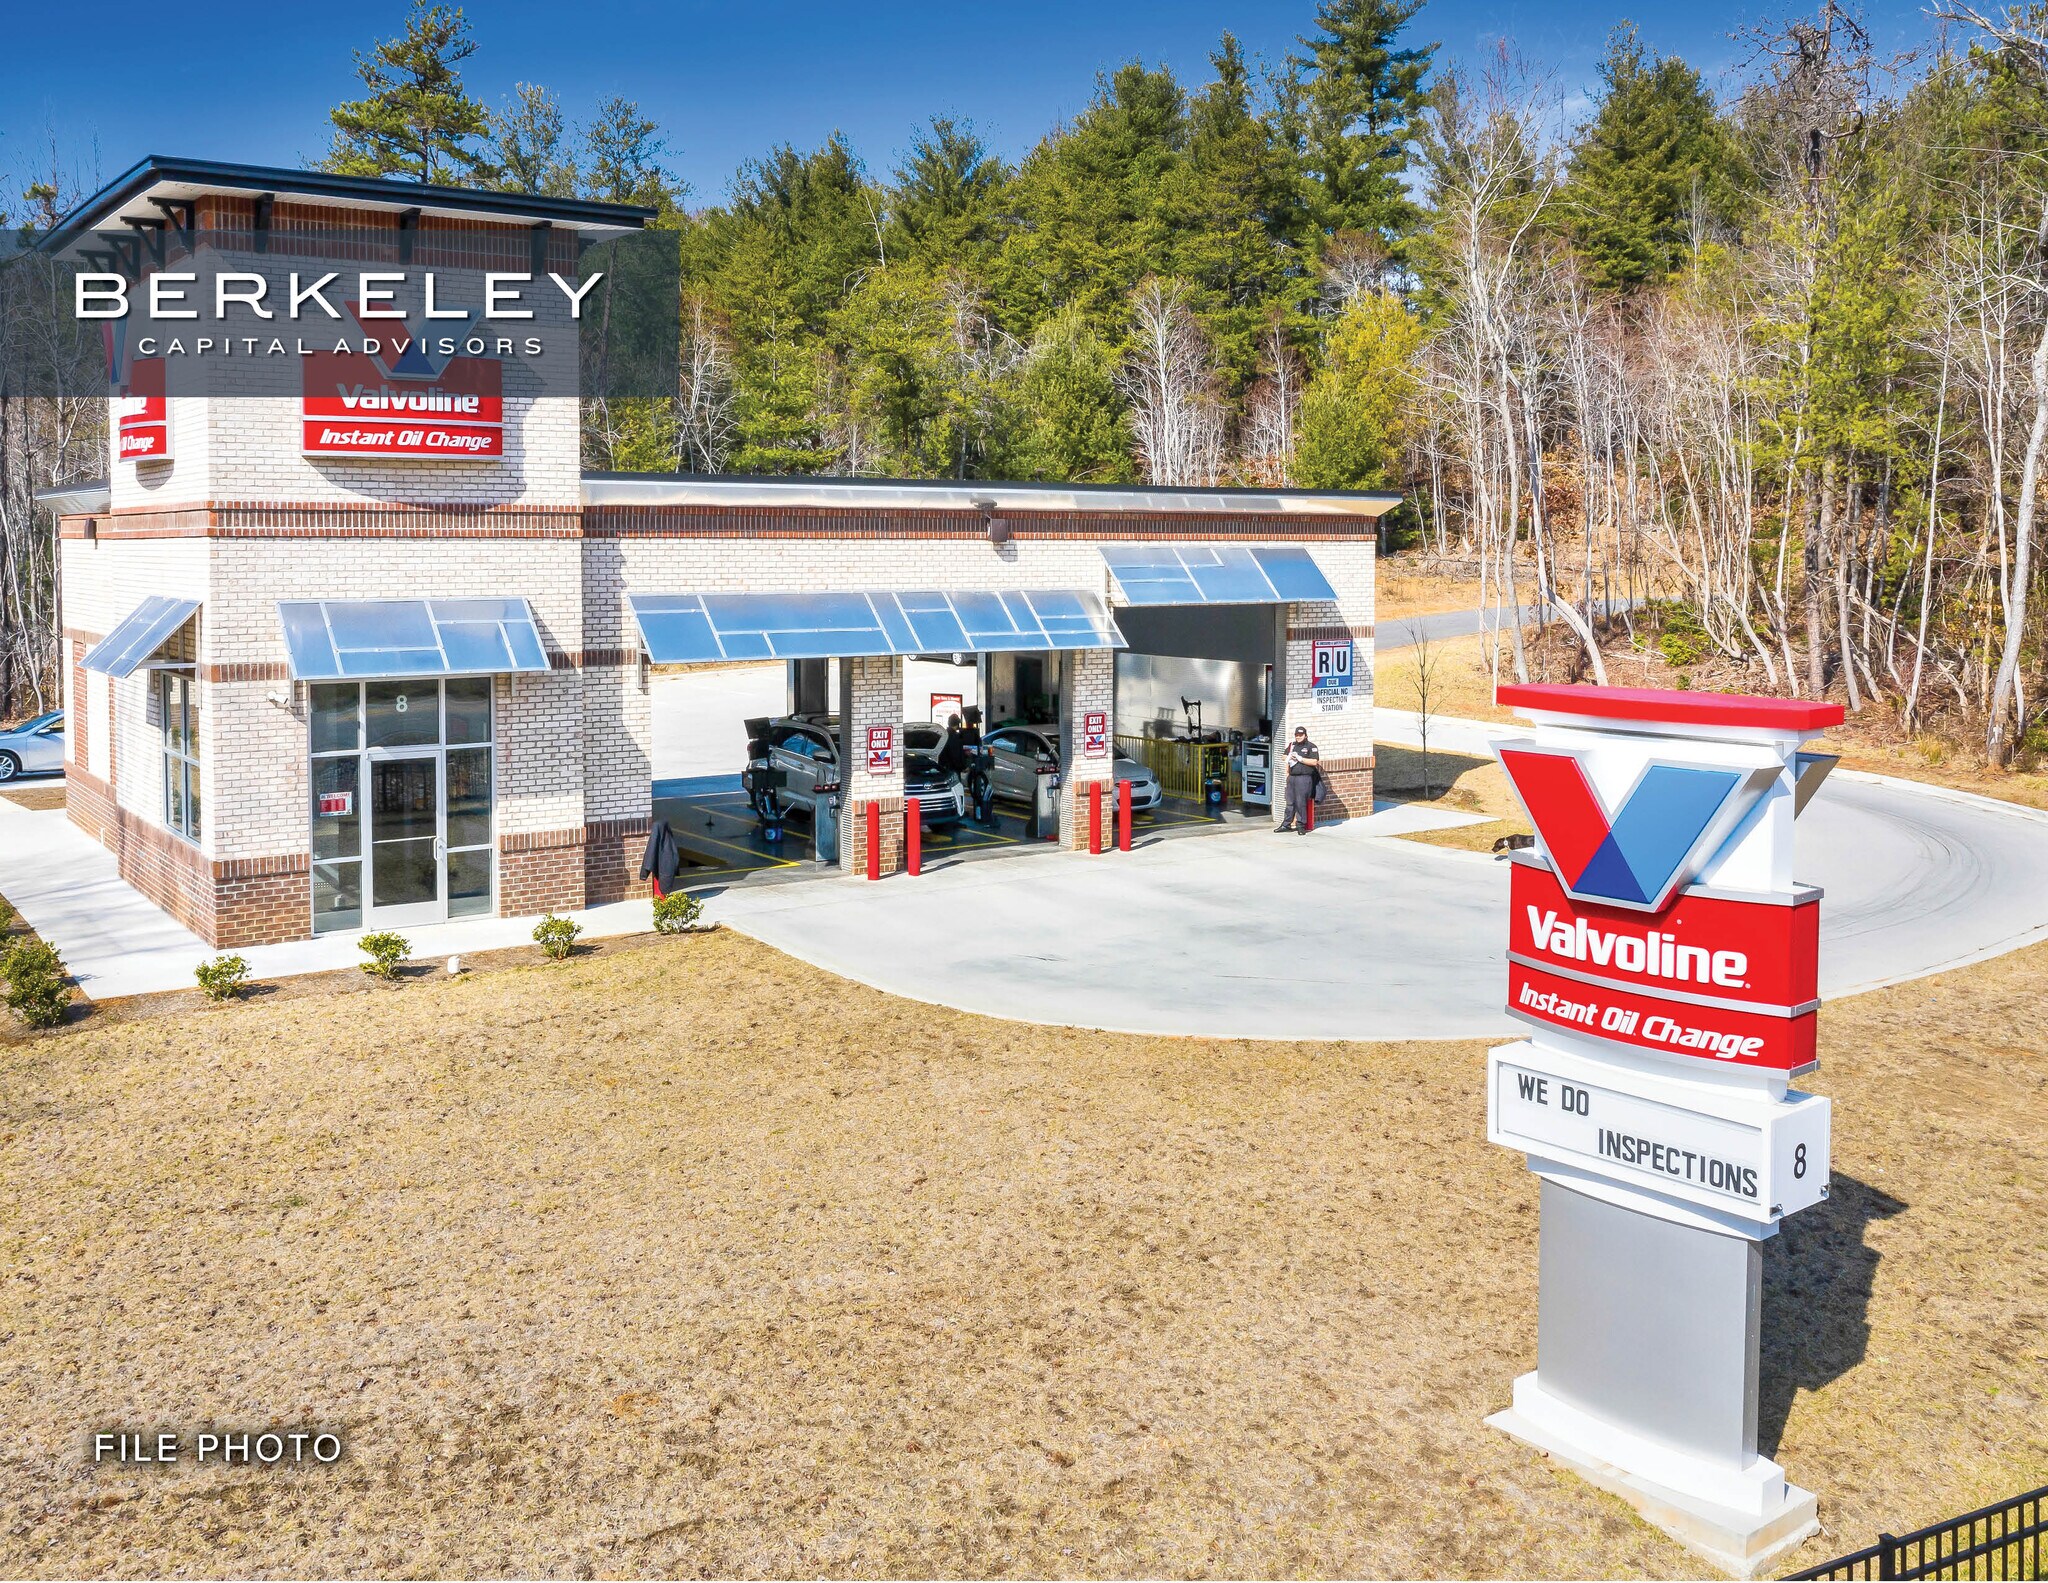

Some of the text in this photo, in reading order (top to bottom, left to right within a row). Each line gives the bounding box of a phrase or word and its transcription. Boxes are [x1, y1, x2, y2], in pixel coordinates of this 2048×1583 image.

[336, 383, 480, 413] Valvoline
[128, 435, 154, 452] Change
[320, 428, 492, 451] Instant Oil Change
[395, 694, 408, 713] 8
[1317, 696, 1347, 704] INSPECTION
[1322, 704, 1343, 712] STATION
[1088, 725, 1103, 733] ONLY
[1089, 716, 1102, 724] EXIT
[872, 730, 889, 739] EXIT
[871, 740, 889, 749] ONLY
[1526, 904, 1749, 989] Valvoline
[1519, 982, 1765, 1060] Instant Oil Change
[1517, 1073, 1590, 1117] WE DO
[1598, 1128, 1758, 1198] INSPECTIONS
[1793, 1142, 1807, 1180] 8
